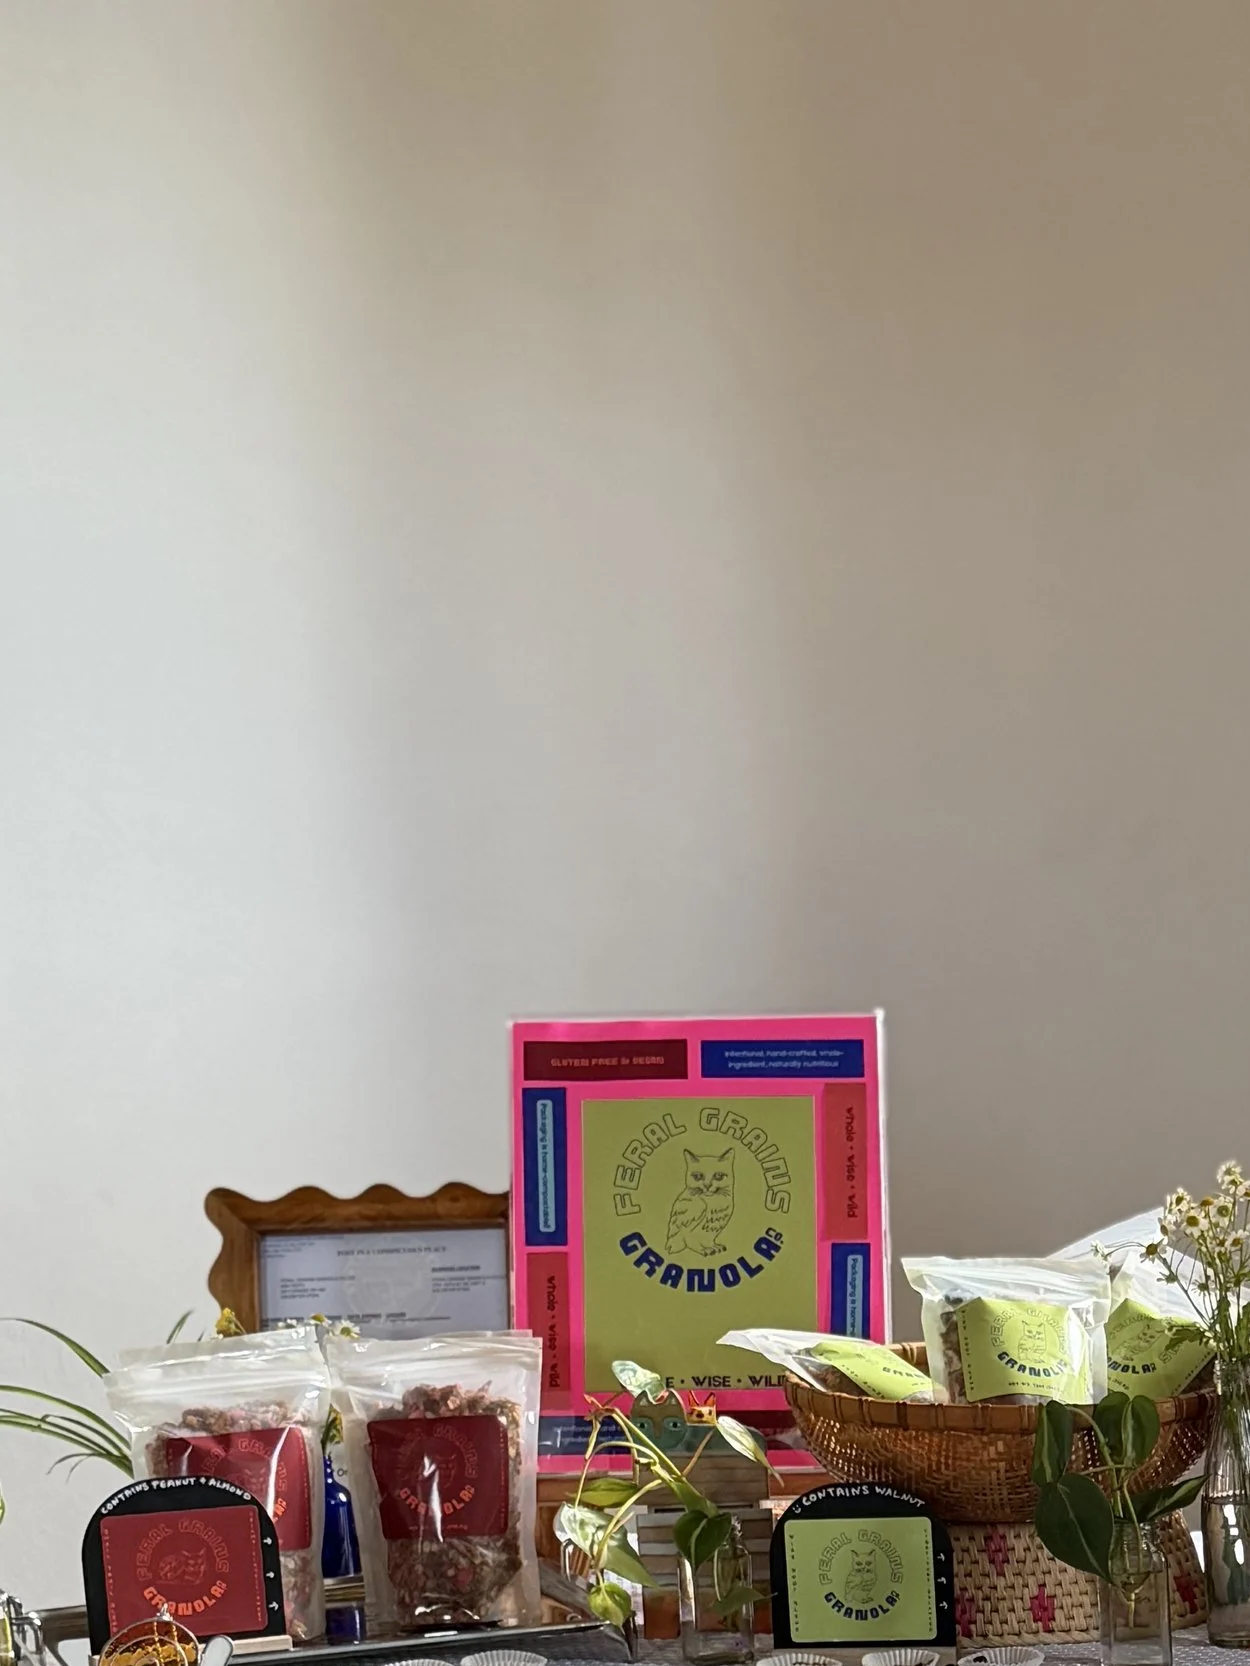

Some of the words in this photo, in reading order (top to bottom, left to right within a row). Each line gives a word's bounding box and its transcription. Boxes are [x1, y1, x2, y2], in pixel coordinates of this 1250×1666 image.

[613, 1112, 688, 1217] FERAL
[699, 1106, 792, 1214] GRAINS
[618, 1231, 780, 1293] GRANOLA
[692, 1375, 731, 1388] WISE
[101, 1482, 150, 1514] CONTAINS
[150, 1477, 196, 1491] PEANUT
[207, 1477, 252, 1501] ALMOND
[801, 1484, 870, 1507] CONTAINS
[874, 1485, 926, 1508] WALNUT
[818, 1532, 853, 1586] FERAL
[858, 1528, 904, 1585] GRAINS
[824, 1591, 897, 1621] GRANOLA
